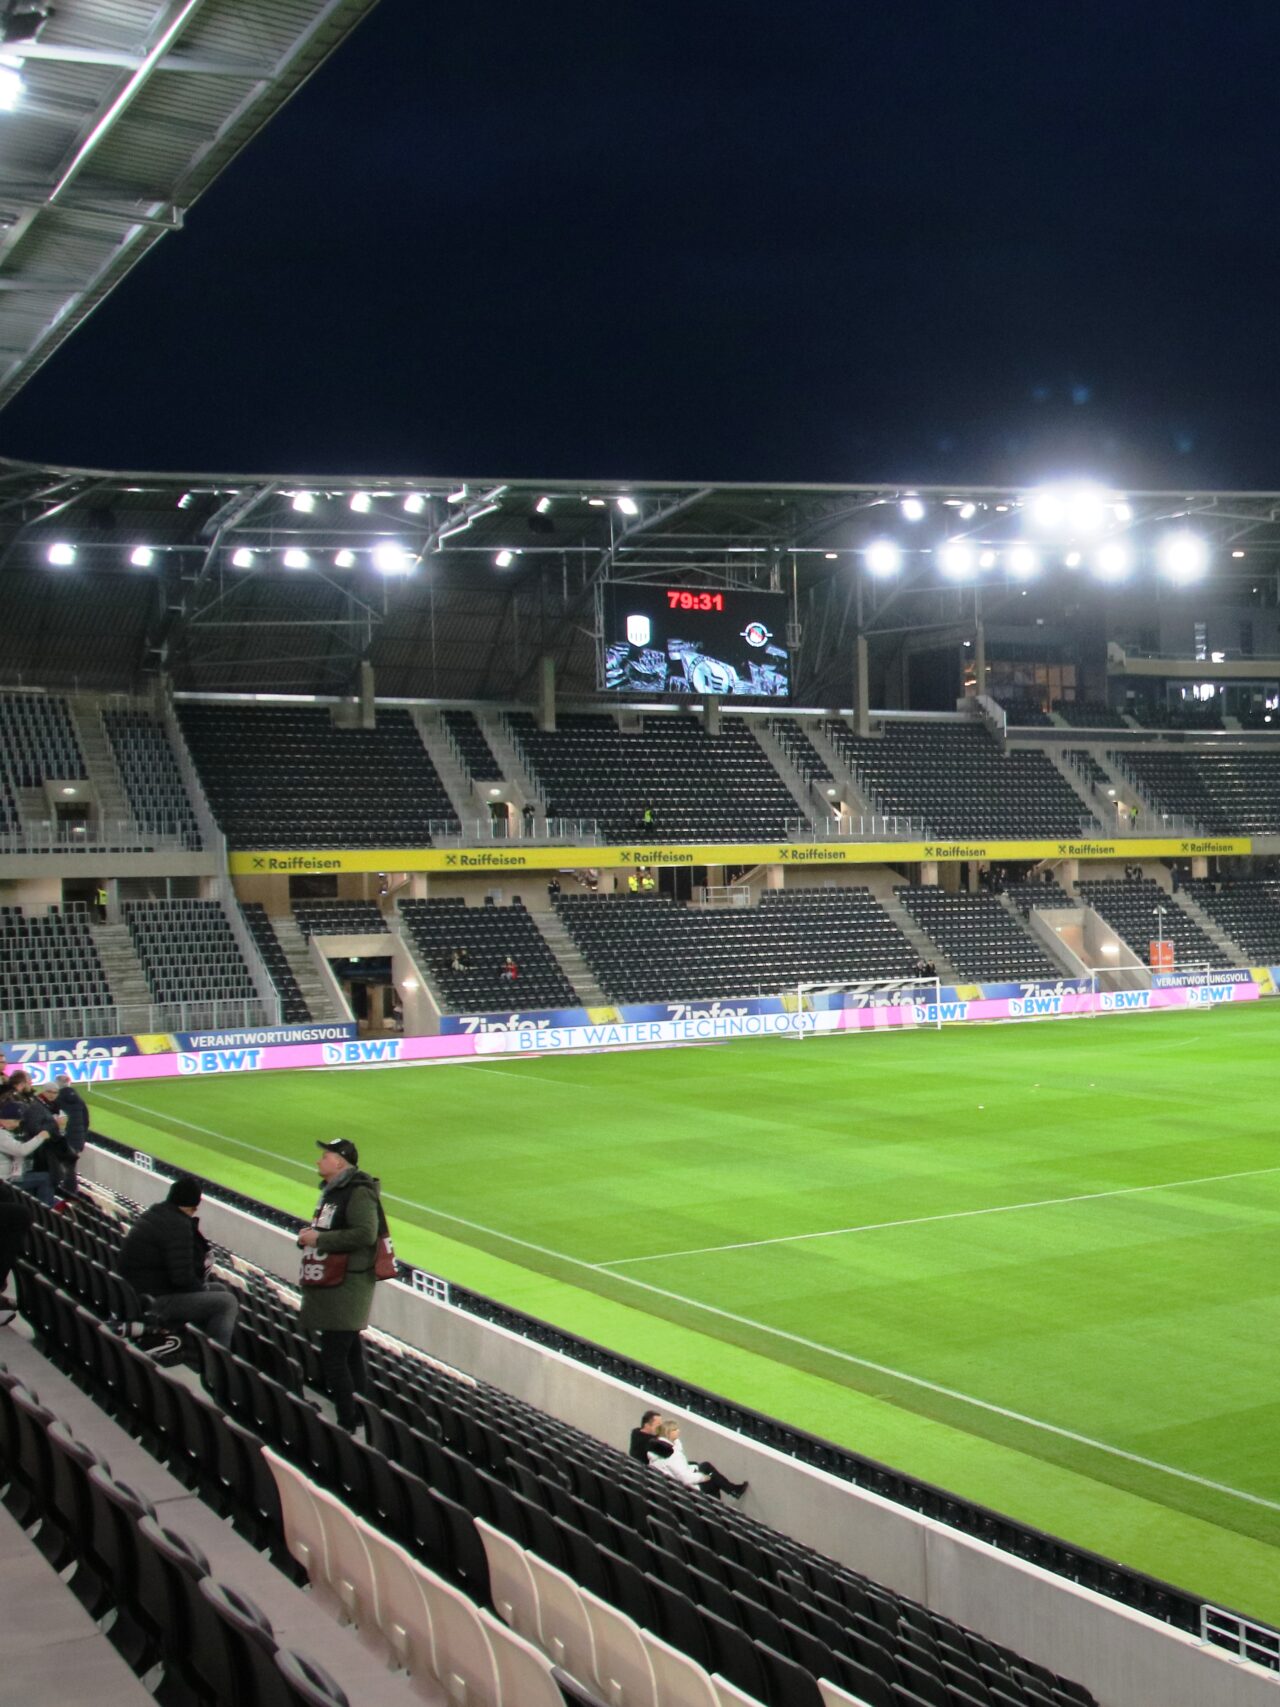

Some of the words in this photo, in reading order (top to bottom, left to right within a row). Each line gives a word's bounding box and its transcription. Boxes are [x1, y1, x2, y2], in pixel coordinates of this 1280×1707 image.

[667, 591, 724, 611] 79:31
[792, 849, 846, 860] Raiffeisen
[935, 847, 986, 857] Raiffeisen
[1068, 845, 1115, 855] Raiffeisen
[1190, 842, 1233, 852] Raiffeisen
[268, 858, 341, 869] Raiffeisen
[460, 854, 526, 866] Raiffeisen
[634, 851, 693, 862] Raiffeisen
[1156, 973, 1249, 987] VERANTWORTUNGSVOLL
[1115, 992, 1149, 1008] BWT
[1201, 986, 1233, 1001] BWT
[928, 1003, 967, 1021] BWT
[1024, 997, 1061, 1014] BWT
[190, 1027, 350, 1048] VERANTWORTUNGSVOLL
[520, 1028, 576, 1050] BEST
[584, 1023, 662, 1045] WATER
[669, 1013, 818, 1038] TECHNOLOGY
[344, 1040, 400, 1061] BWT
[201, 1050, 260, 1071] BWT
[48, 1059, 115, 1082] BWT
